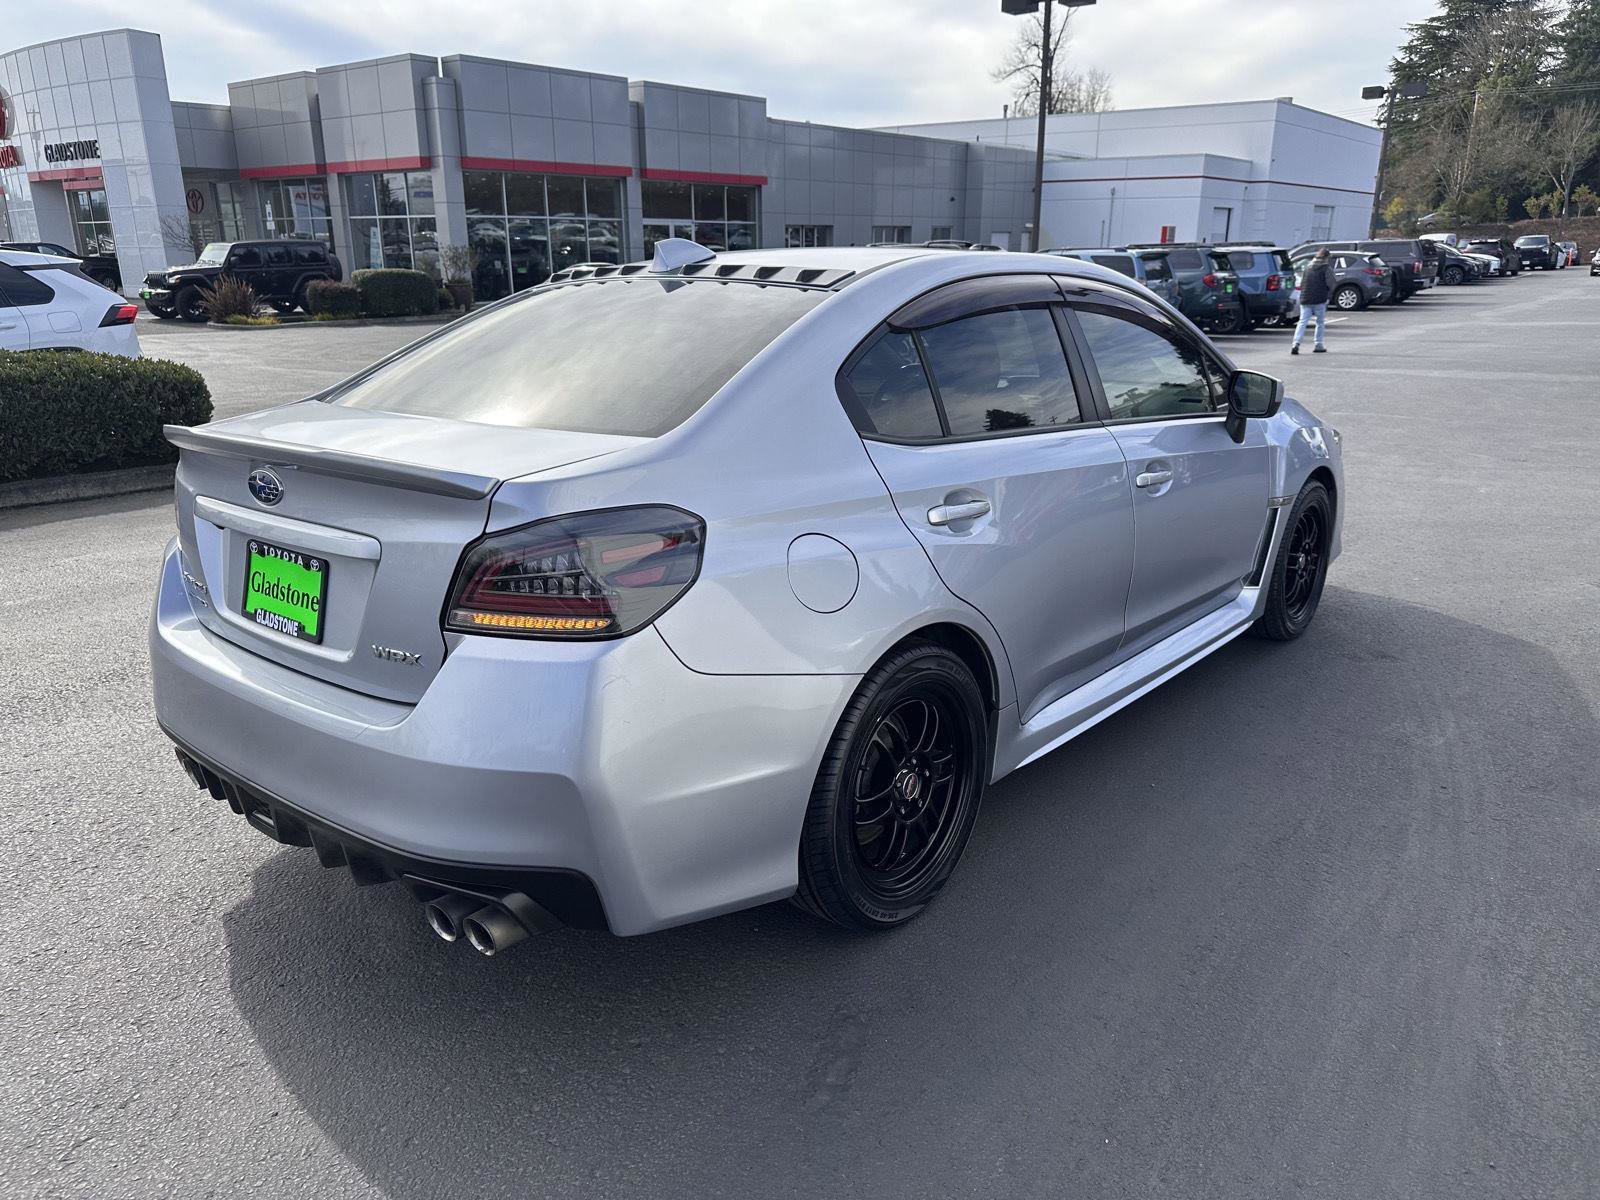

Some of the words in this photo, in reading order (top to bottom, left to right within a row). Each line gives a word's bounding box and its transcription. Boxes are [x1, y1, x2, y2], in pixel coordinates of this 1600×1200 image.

[44, 140, 100, 163] GLADSTONE
[263, 545, 304, 566] TOYOTA
[251, 571, 319, 613] Gladstone
[256, 609, 299, 637] GLADSTONE
[371, 644, 424, 668] WRX
